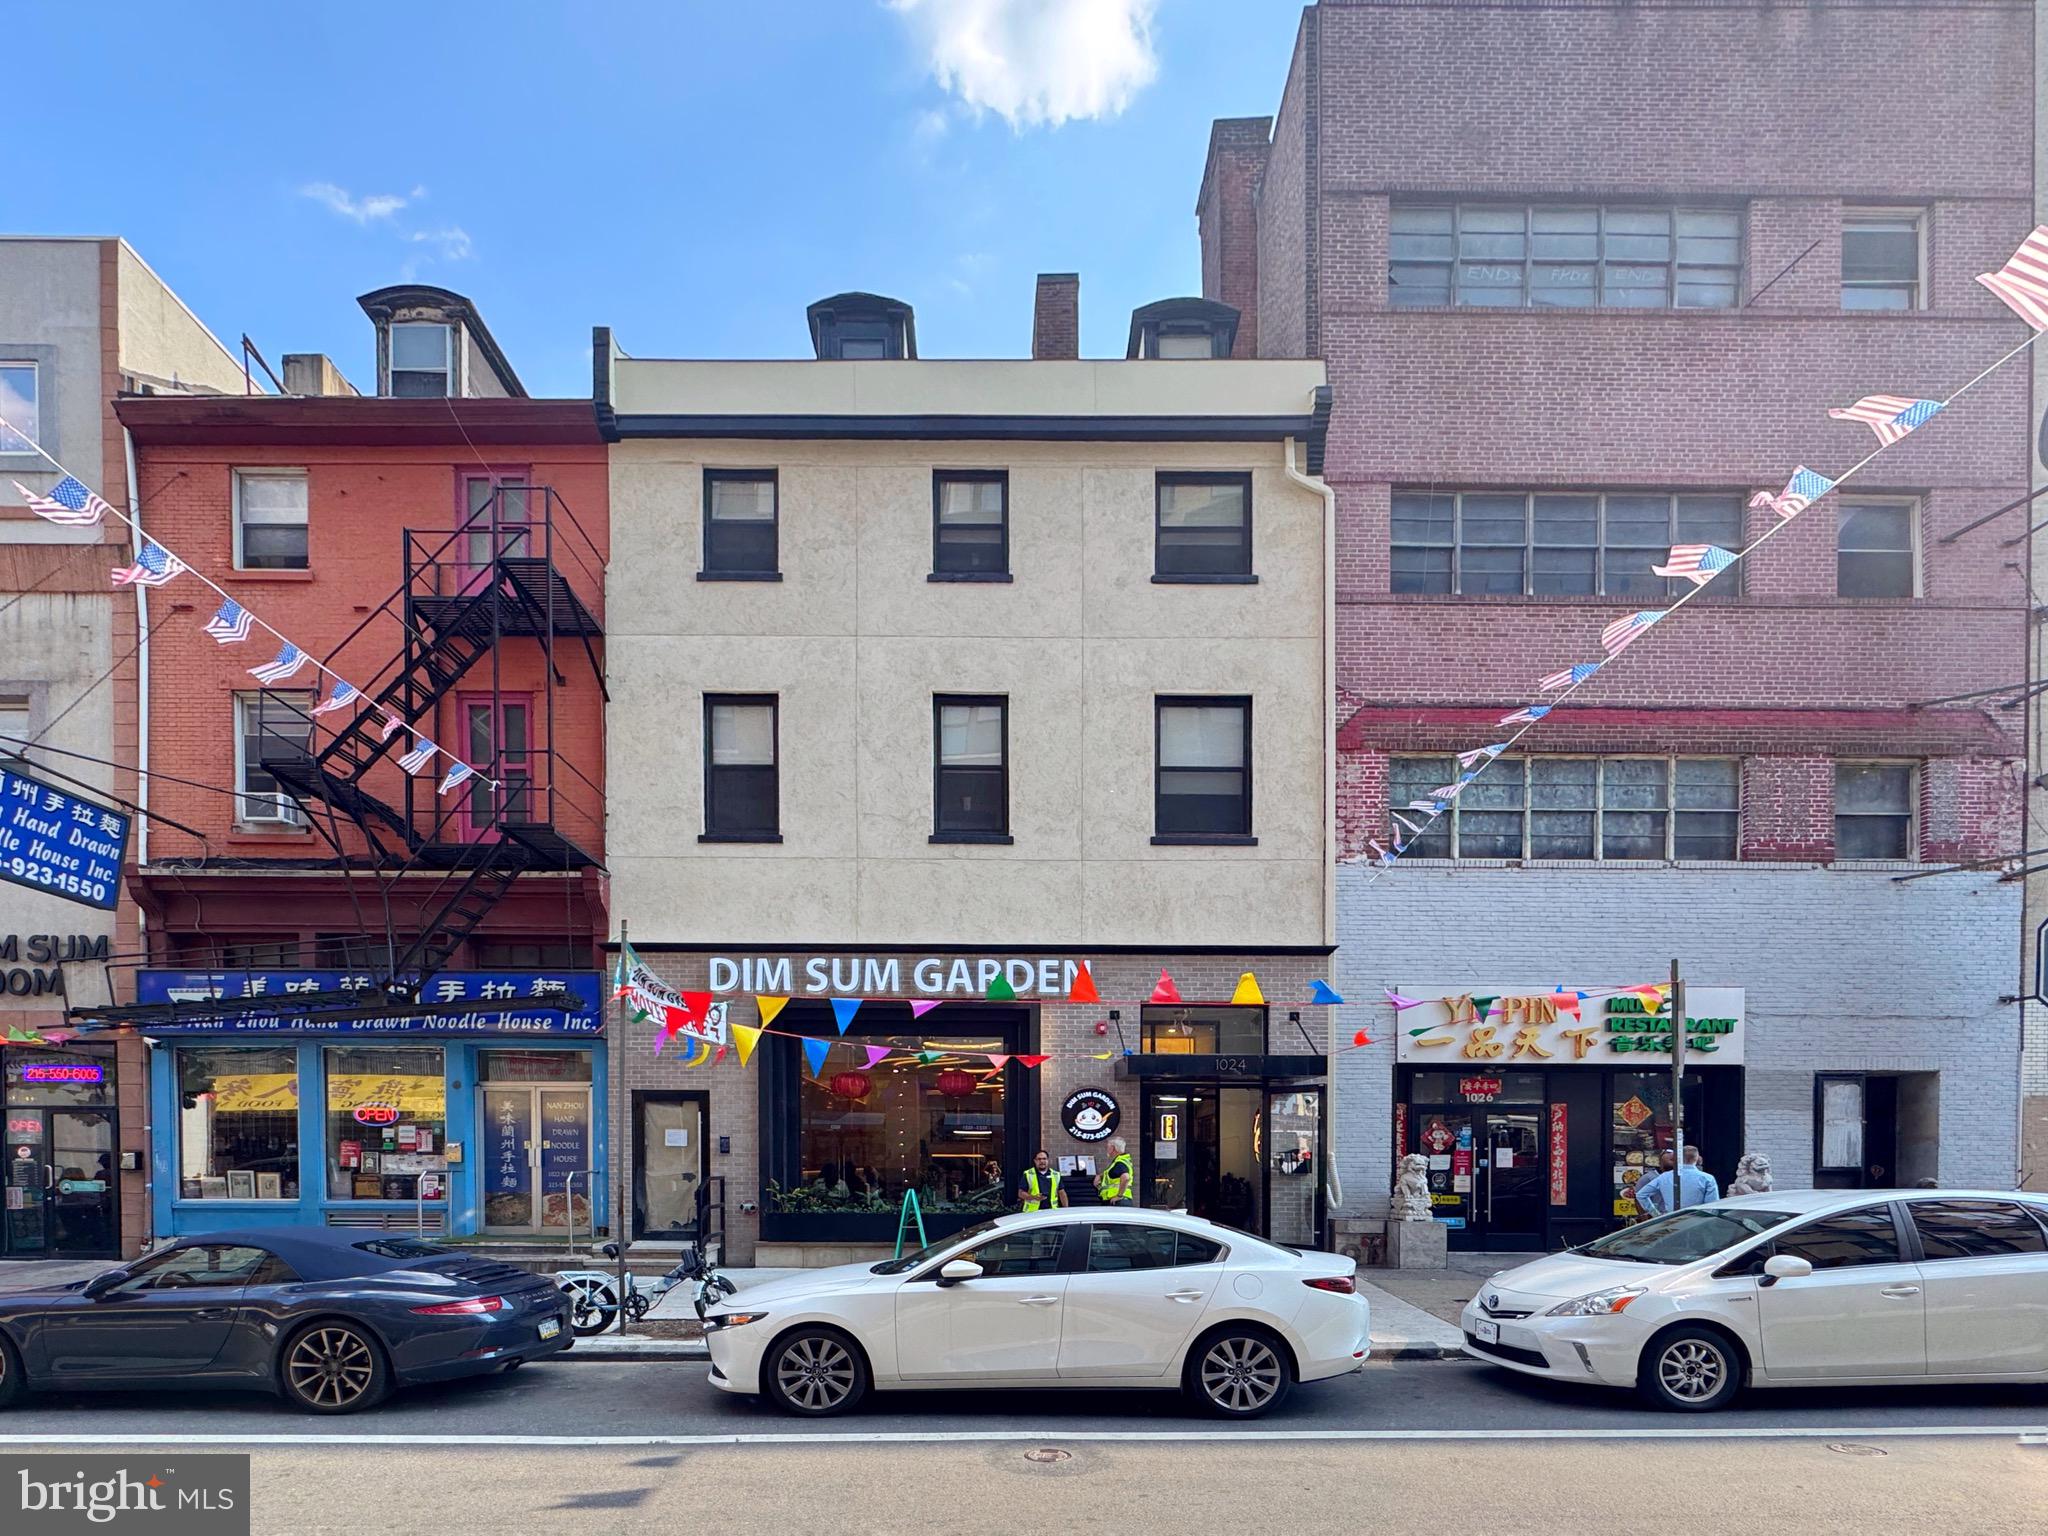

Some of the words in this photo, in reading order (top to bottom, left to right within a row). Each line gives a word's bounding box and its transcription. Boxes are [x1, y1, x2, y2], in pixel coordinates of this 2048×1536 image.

[13, 806, 62, 839] Hand
[68, 828, 121, 861] Drawn
[29, 839, 80, 871] House
[87, 859, 116, 884] Inc.
[27, 934, 109, 963] SUM
[0, 968, 64, 996] OM
[709, 957, 792, 992] DIM
[806, 957, 899, 993] SUM
[1502, 996, 1559, 1024] PIN
[422, 1012, 486, 1030] Noodle
[498, 1012, 552, 1030] House
[564, 1012, 598, 1031] Inc.
[1608, 1016, 1738, 1034] RESTARANT
[1415, 1025, 1600, 1060] 一品天下
[1215, 1058, 1247, 1072] 1024
[546, 1102, 562, 1110] NAN
[563, 1102, 584, 1110] ZHOU
[1066, 1097, 1078, 1109] DIM
[1077, 1091, 1092, 1100] SUM
[1092, 1091, 1116, 1110] GARDEN
[1465, 1093, 1494, 1103] 1026
[356, 1107, 396, 1121] OPEN
[554, 1115, 575, 1123] HAND
[552, 1128, 579, 1136] DRAWN
[553, 1155, 577, 1163] HOUSE
